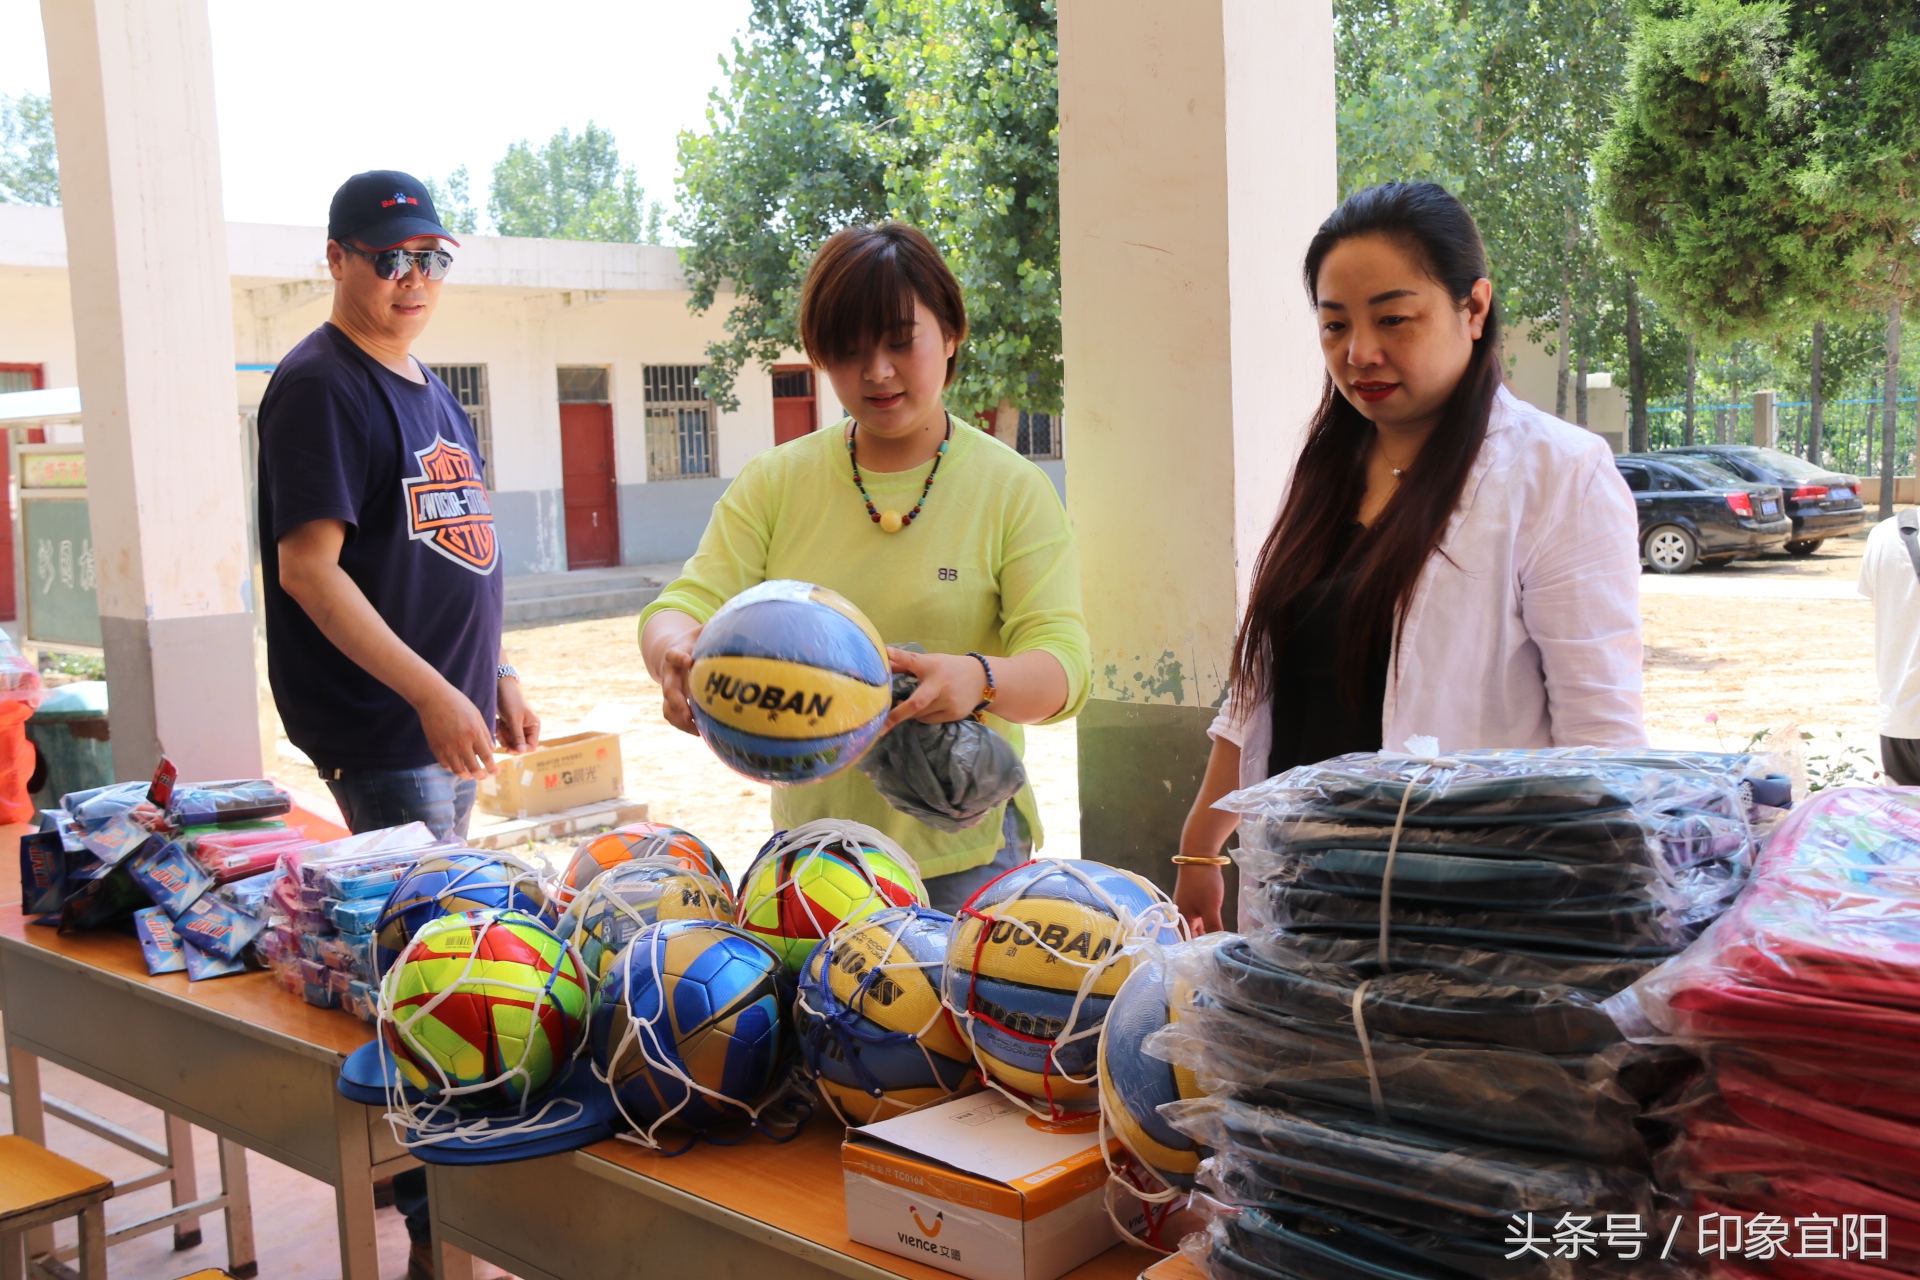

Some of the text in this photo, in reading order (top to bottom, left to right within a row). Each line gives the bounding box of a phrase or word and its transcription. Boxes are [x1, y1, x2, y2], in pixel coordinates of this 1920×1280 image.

[704, 670, 834, 717] HUOBAN
[28, 846, 54, 890] JUMP
[150, 868, 190, 894] JUMP
[145, 918, 180, 953] JUMP
[186, 918, 235, 939] JUMP
[894, 1169, 925, 1187] TC0104
[897, 1231, 939, 1254] vience
